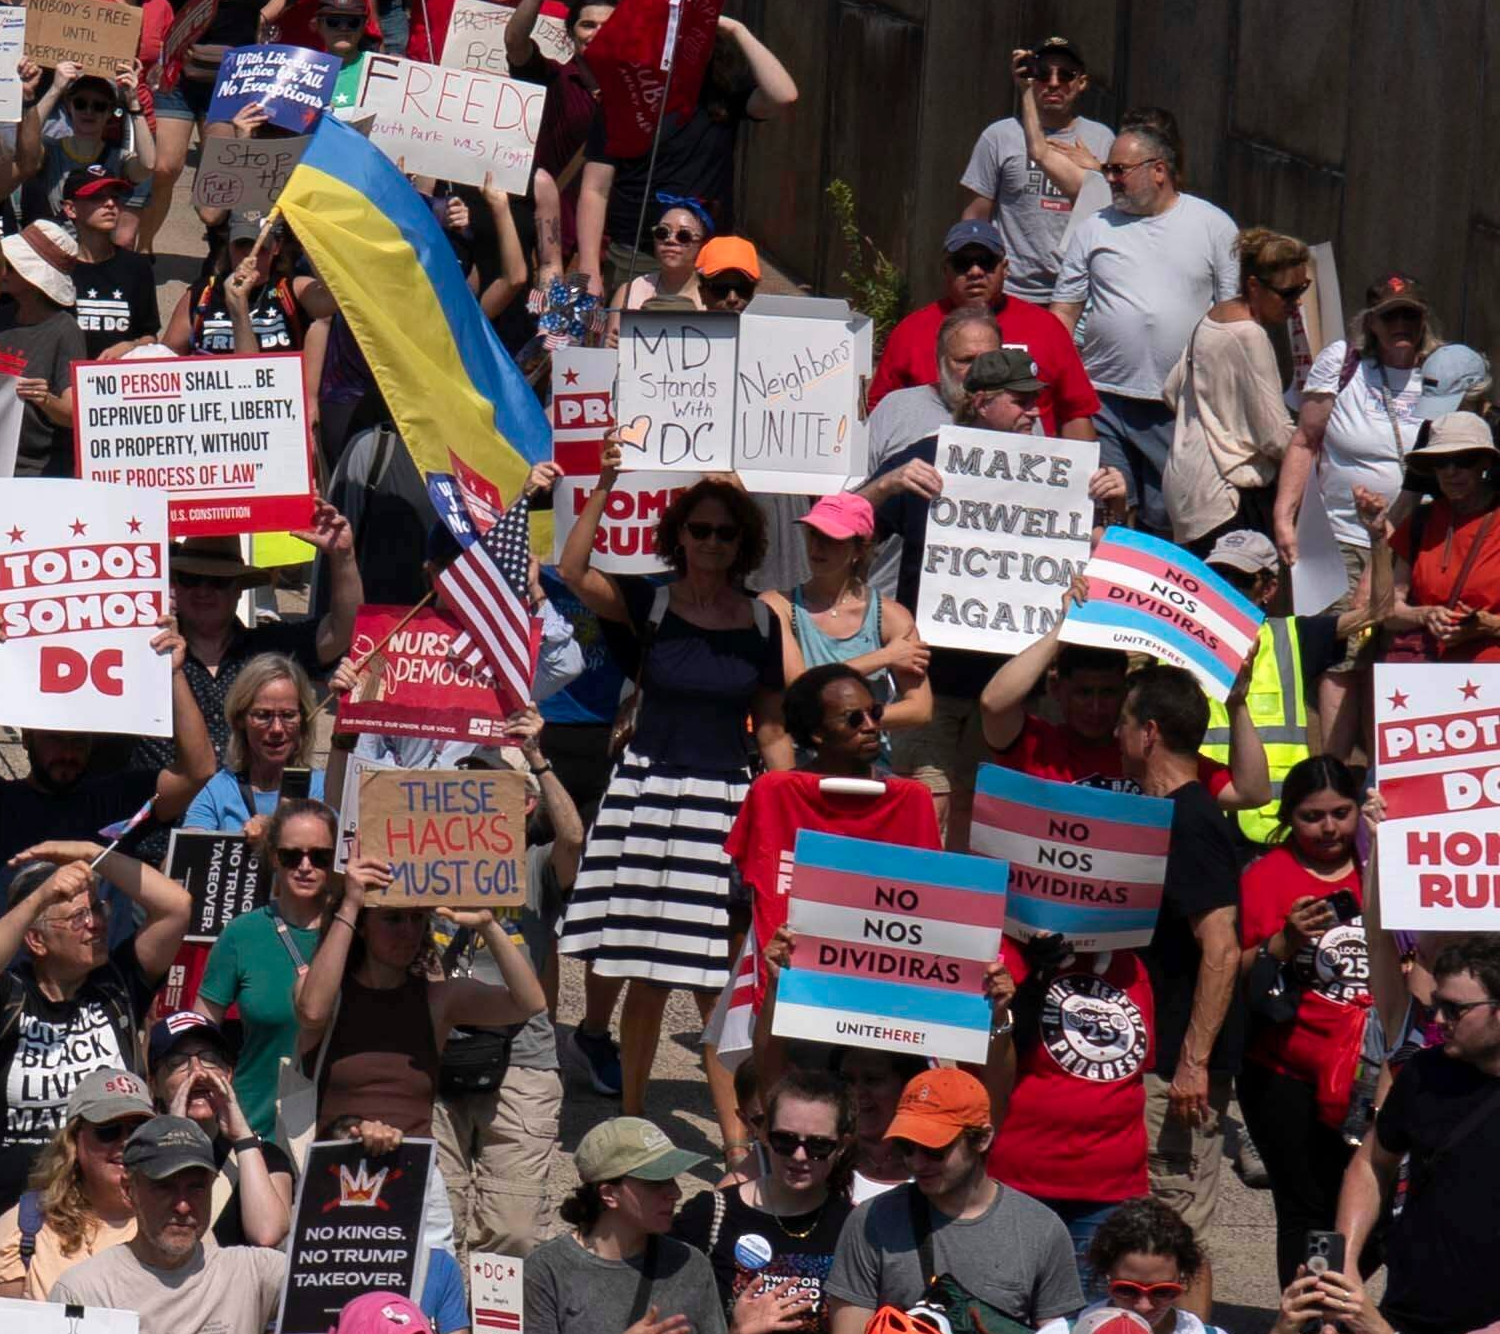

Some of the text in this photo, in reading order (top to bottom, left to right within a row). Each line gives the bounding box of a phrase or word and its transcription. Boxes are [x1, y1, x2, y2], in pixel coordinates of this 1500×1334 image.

[121, 373, 181, 394] PERSON
[186, 370, 233, 391] SHALL
[256, 369, 275, 388] BE
[738, 344, 853, 404] Neighbors
[89, 399, 295, 427] DEPRIVED OF LIFE, LIBERTY,
[91, 432, 269, 458] OR PROPERTY, WITHOUT
[741, 412, 847, 462] UNITE!
[126, 466, 195, 487] PROCESS
[200, 466, 217, 484] OF
[945, 446, 1073, 490] MAKE
[171, 507, 250, 521] U.S. CONSTITUTION
[930, 498, 1092, 542] ORWELL
[926, 546, 1087, 589] FICTION
[932, 595, 1062, 638] AGAIN
[383, 817, 515, 857] HACKS
[390, 861, 520, 898] MUST GO!
[874, 886, 920, 913] NO
[863, 916, 924, 945] NOS
[818, 944, 961, 986] DIVIDIRÁS
[836, 1020, 927, 1047] UNITEHERE!
